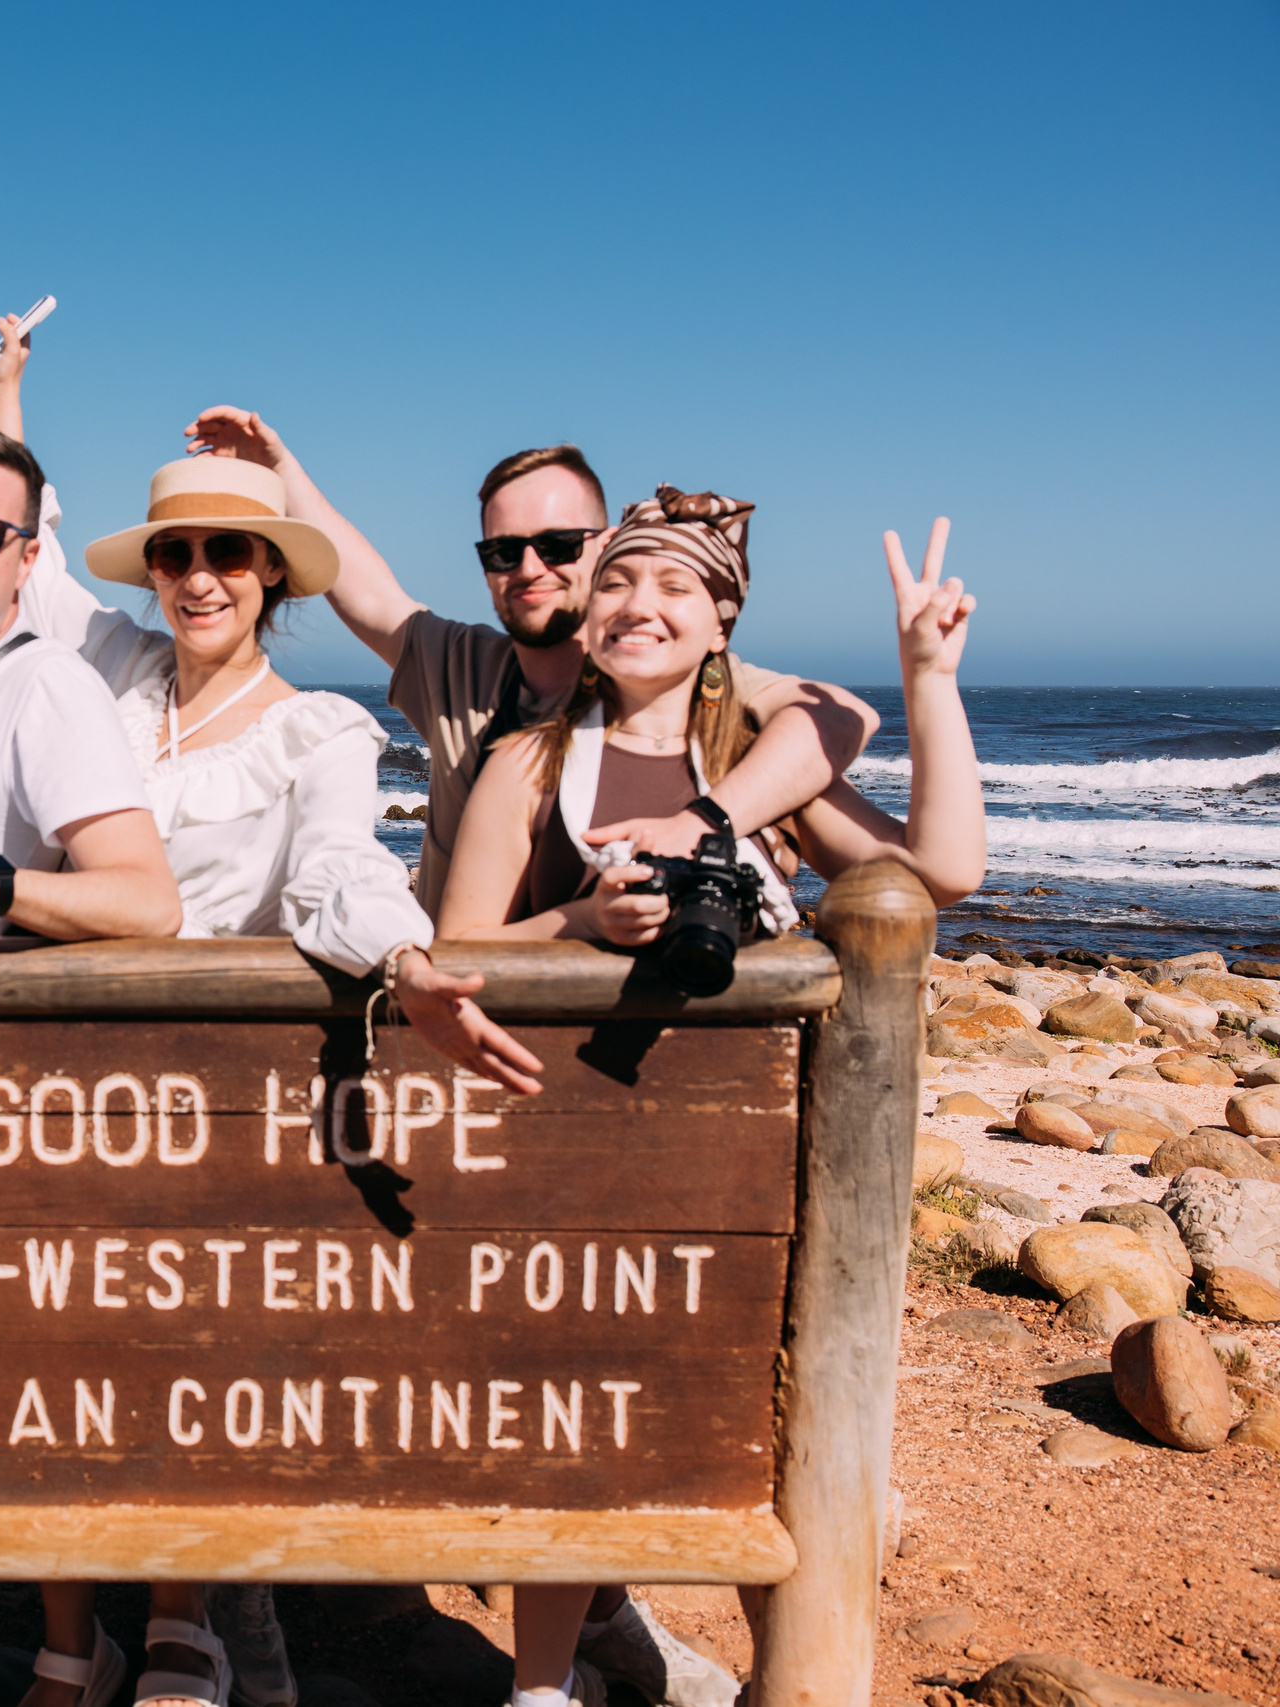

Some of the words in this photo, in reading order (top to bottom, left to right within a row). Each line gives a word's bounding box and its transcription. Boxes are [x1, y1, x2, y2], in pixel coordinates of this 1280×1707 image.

[265, 1072, 508, 1171] HOPE
[469, 1241, 715, 1314] POINT
[168, 1375, 642, 1452] CONTINENT
